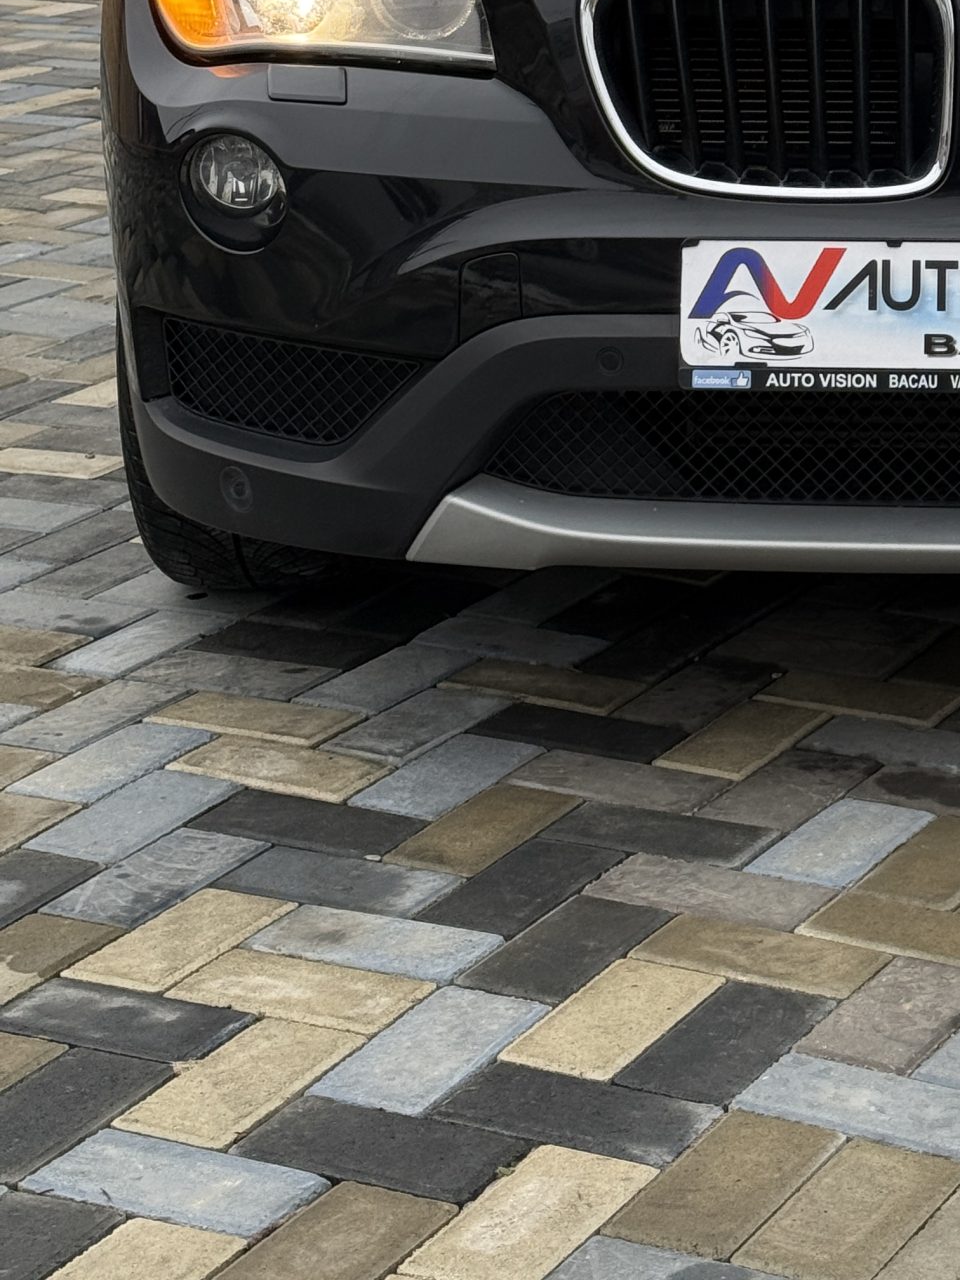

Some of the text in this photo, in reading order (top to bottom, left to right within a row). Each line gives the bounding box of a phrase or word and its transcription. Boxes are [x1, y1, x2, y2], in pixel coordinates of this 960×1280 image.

[694, 374, 730, 386] facebook
[766, 373, 815, 388] AUTO
[819, 373, 877, 388] VISION
[888, 374, 938, 389] BACAU
